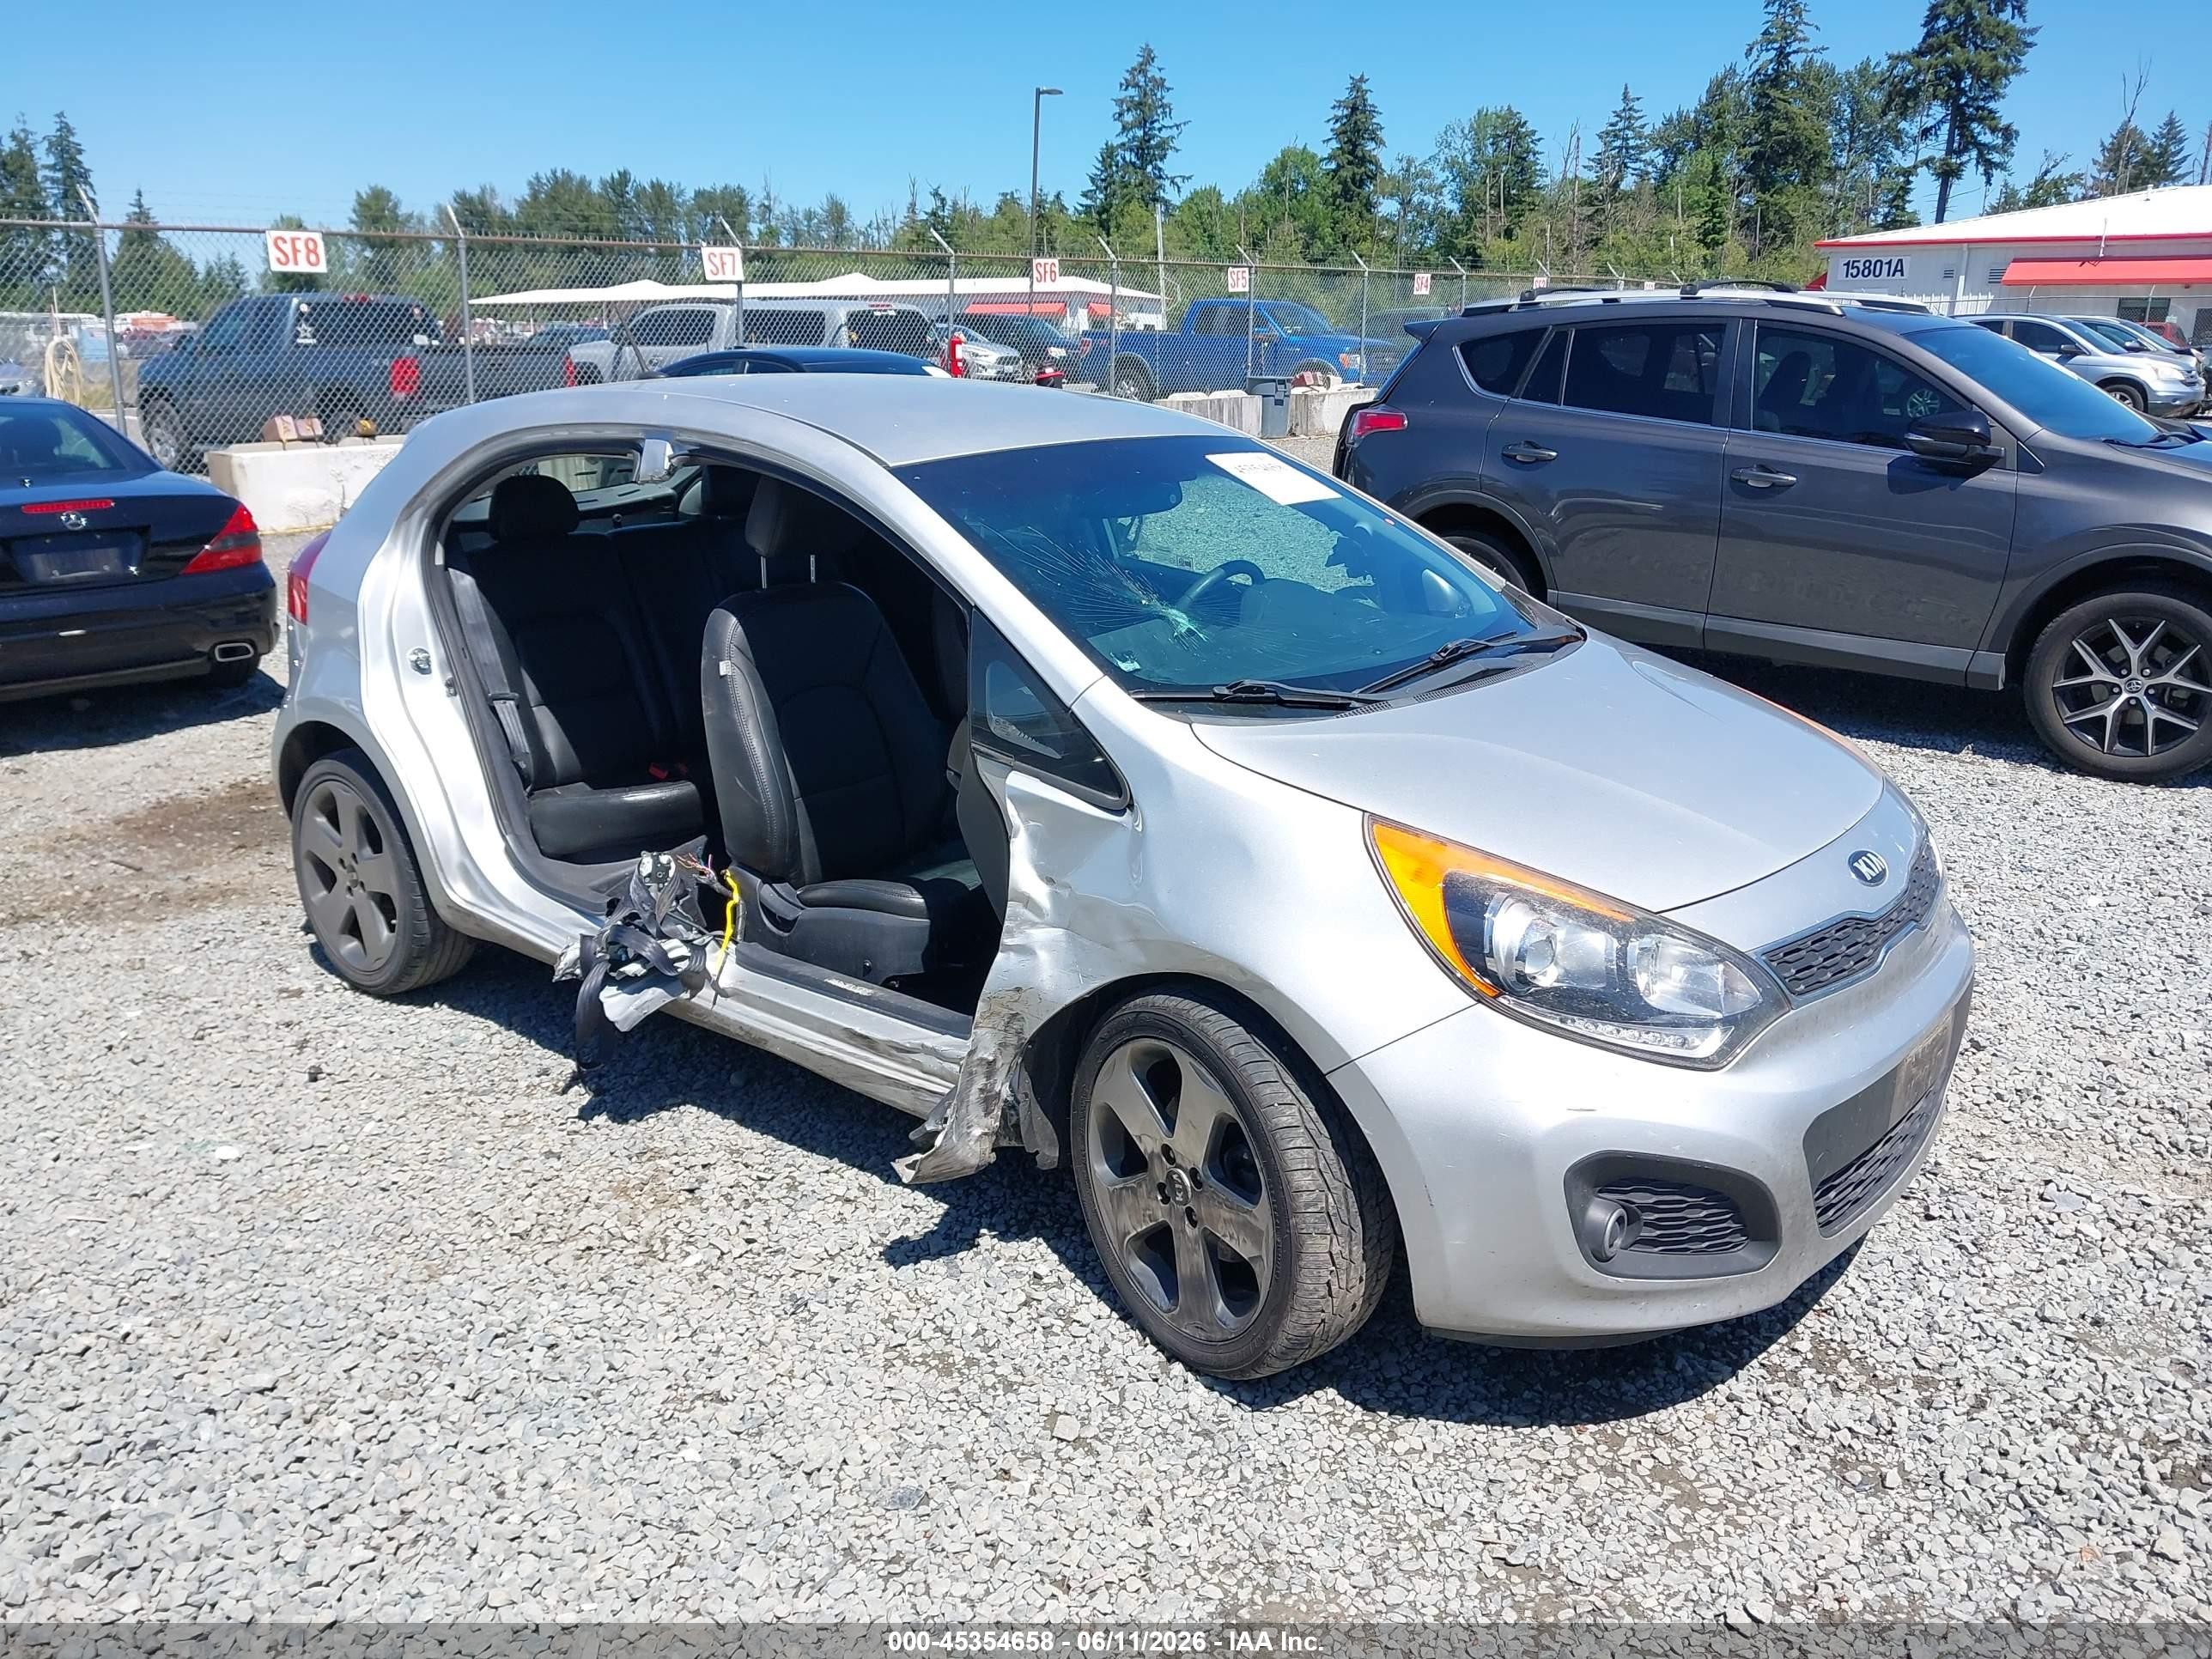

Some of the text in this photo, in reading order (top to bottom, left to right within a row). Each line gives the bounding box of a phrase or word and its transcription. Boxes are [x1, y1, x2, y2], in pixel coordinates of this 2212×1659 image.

[273, 236, 320, 266] SF8
[708, 252, 736, 276] SF7
[1035, 262, 1057, 283] SF6
[1843, 258, 1905, 278] 15801A
[1230, 270, 1248, 289] SF5
[1415, 276, 1429, 292] SF4
